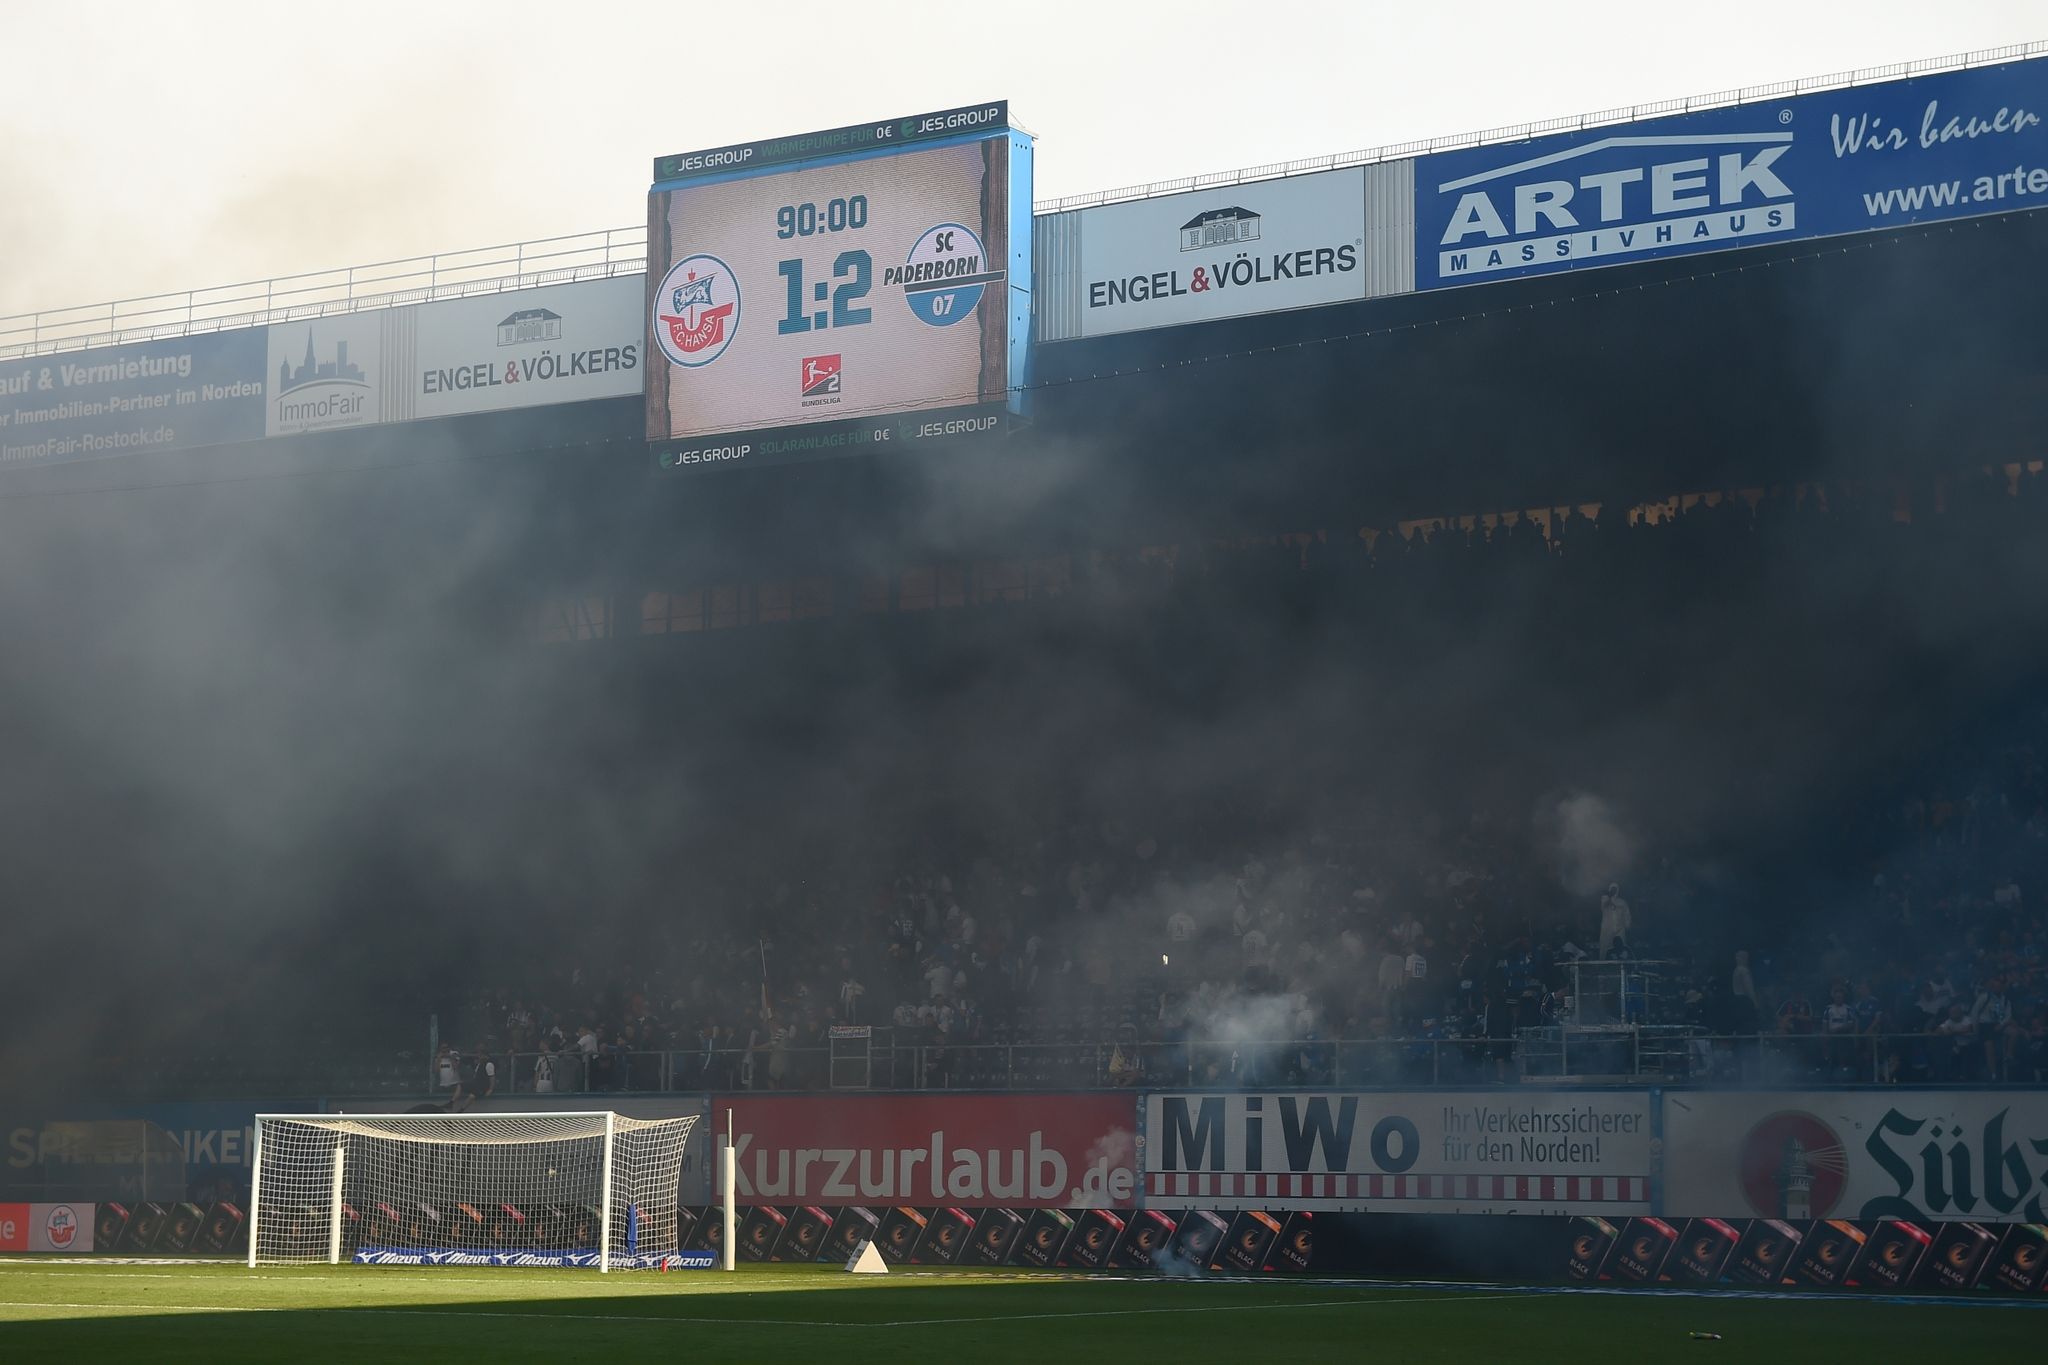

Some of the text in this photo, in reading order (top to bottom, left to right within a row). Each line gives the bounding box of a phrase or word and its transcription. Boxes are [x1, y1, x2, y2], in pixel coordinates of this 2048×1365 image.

[917, 108, 999, 133] JES.GROUP
[1829, 101, 2041, 158] Wir bauen
[678, 148, 753, 172] JES.GROUP
[876, 125, 892, 139] 0€
[1440, 145, 1794, 246] ARTEK
[776, 194, 868, 240] 90:00
[935, 231, 954, 253] SC
[1450, 210, 1783, 272] MASSIVHAUS
[883, 255, 979, 287] PADERBORN
[1090, 243, 1357, 309] ENGEL&VÖLKERS
[777, 248, 873, 336] 1:2
[932, 293, 956, 317] 07
[37, 366, 54, 391] &
[61, 354, 192, 387] Vermietung
[423, 344, 638, 394] ENGEL&VÖLKERS
[827, 374, 839, 392] 2
[15, 393, 171, 425] Immobilien-Partner
[176, 388, 196, 405] im
[202, 380, 262, 402] Norden
[279, 392, 365, 422] ImmoFair
[801, 396, 841, 408] BUNDESLIGA
[916, 416, 998, 438] JES.GROUP
[675, 444, 751, 466] JES.GROUP
[759, 433, 845, 455] SOLARANLAGE
[874, 428, 890, 442] 0€
[1443, 1106, 1643, 1134] Ihr Verkehrssicherer
[1162, 1096, 1420, 1173] MiWo
[1442, 1136, 1601, 1164] für den Norden!
[934, 1244, 952, 1260] BLACK
[982, 1245, 1000, 1261] BLACK
[1031, 1247, 1049, 1264] BLACK
[1081, 1247, 1099, 1264] BLACK
[1132, 1248, 1151, 1266] BLACK
[1236, 1249, 1256, 1266] BLACK
[1289, 1250, 1309, 1268] BLACK
[1569, 1258, 1590, 1275] BLACK
[1628, 1260, 1649, 1277] BLACK
[1689, 1260, 1710, 1278] BLACK
[1751, 1262, 1772, 1280] BLACK
[1813, 1263, 1835, 1281] BLACK
[1877, 1264, 1899, 1283] BLACK
[1943, 1266, 1965, 1284] BLACK
[2009, 1268, 2032, 1287] BLACK
